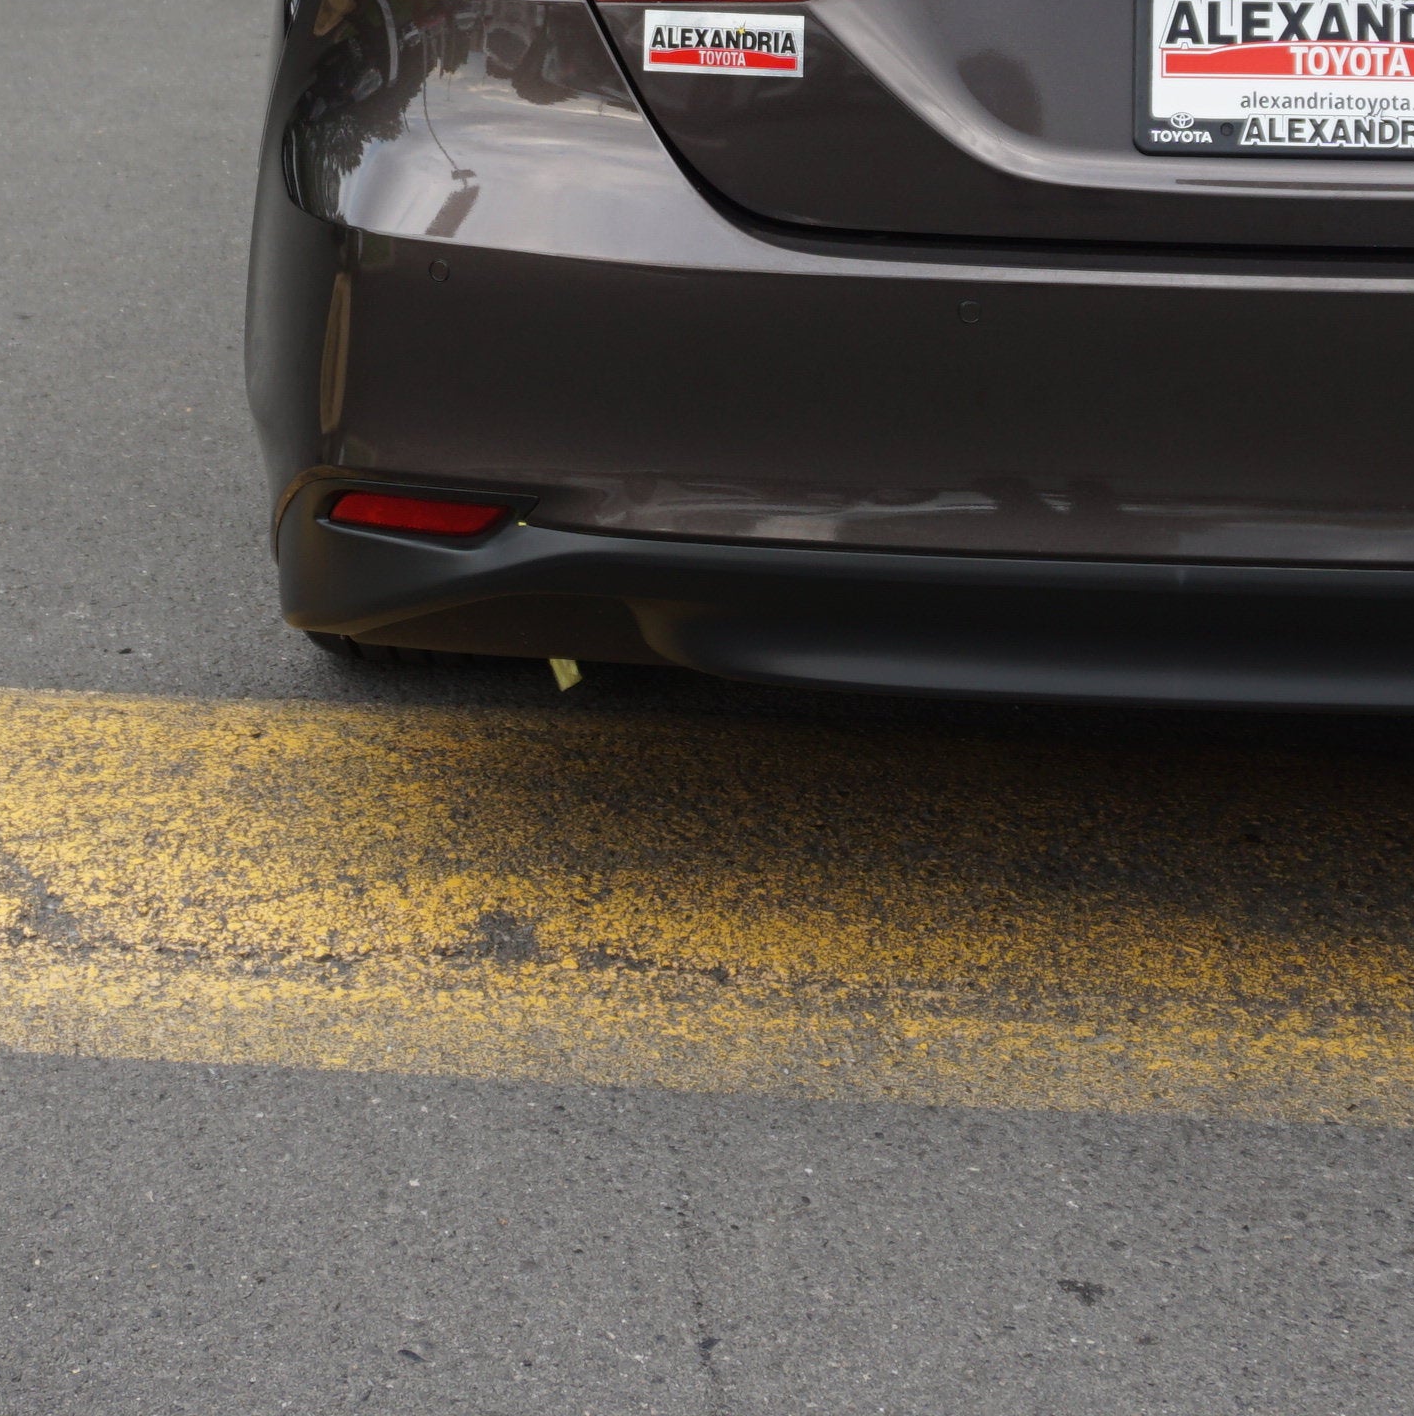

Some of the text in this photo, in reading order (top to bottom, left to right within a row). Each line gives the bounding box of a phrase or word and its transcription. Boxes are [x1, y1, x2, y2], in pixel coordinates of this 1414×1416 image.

[651, 26, 797, 54] ALEXANDRIA
[699, 50, 746, 66] TOYOTA
[1289, 45, 1412, 78] TOYOTA
[1151, 129, 1213, 145] TOYOTA
